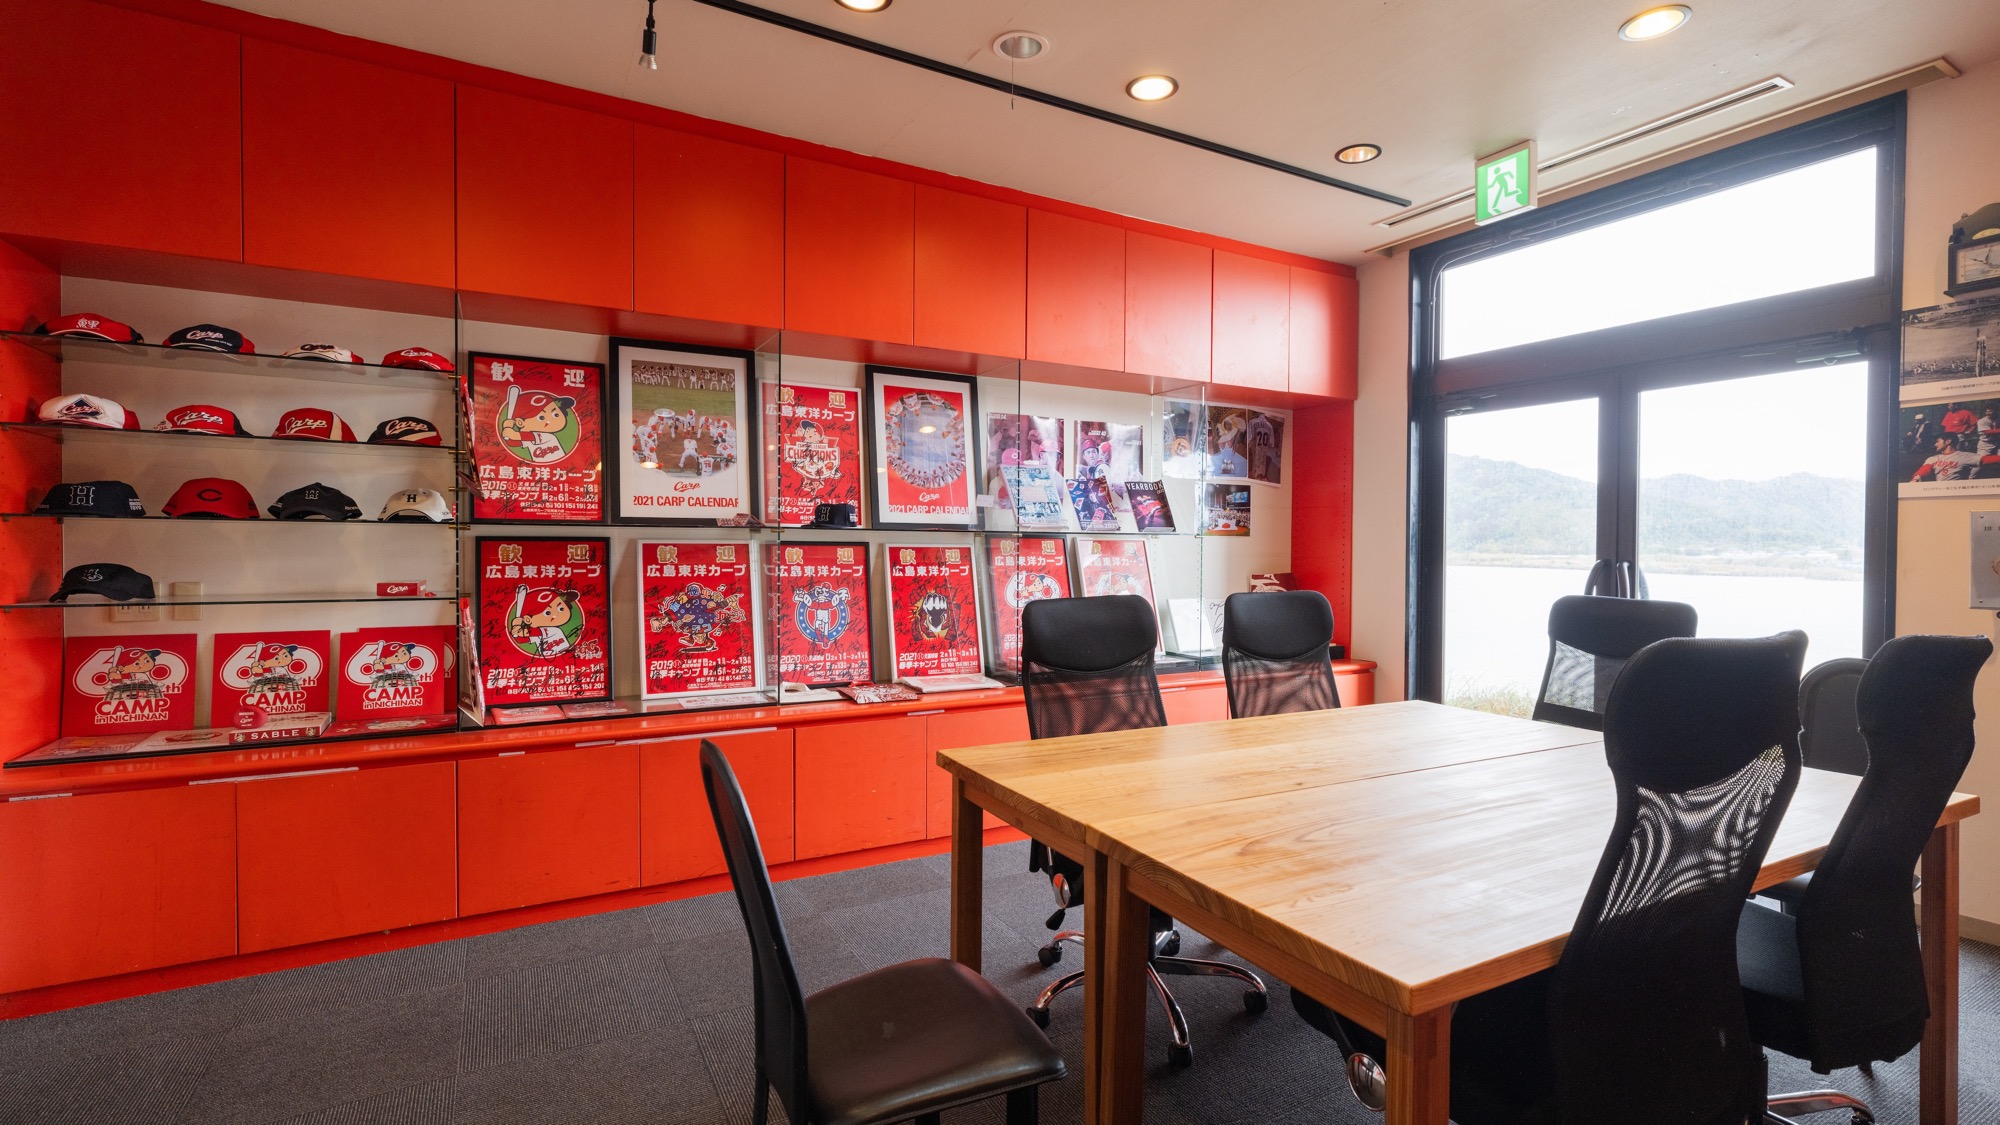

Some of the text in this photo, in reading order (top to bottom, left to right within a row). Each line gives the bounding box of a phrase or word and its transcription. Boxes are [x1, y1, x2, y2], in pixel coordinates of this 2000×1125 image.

[491, 361, 585, 388] 歓 迎
[174, 410, 224, 427] Carp
[284, 417, 328, 435] Carp
[385, 419, 429, 436] Carp
[673, 481, 701, 493] Carp
[1126, 481, 1164, 491] YEARBOOK
[69, 485, 96, 507] H
[197, 488, 223, 502] C
[406, 494, 417, 503] H
[656, 496, 685, 507] CARP
[919, 492, 940, 502] Carp
[906, 505, 928, 514] CARP
[499, 544, 589, 564] 歓 迎
[1000, 540, 1055, 555] 歓 迎
[657, 546, 736, 563] 歓 迎
[785, 548, 854, 564] 歓 迎
[900, 549, 961, 565] 歓 迎
[486, 565, 602, 578] 広島東洋カープ
[647, 564, 746, 577] 広島東洋カープ
[775, 565, 864, 577] 広島東洋カープ
[892, 565, 970, 577] 広島東洋カープ
[241, 690, 306, 706] CAMP
[364, 686, 423, 702] CAMP
[96, 698, 170, 717] CAMP
[264, 704, 305, 713] CHINAN
[374, 698, 423, 708] NICHINAN
[95, 711, 168, 724] in NICHINAN
[250, 729, 300, 740] SABLE
